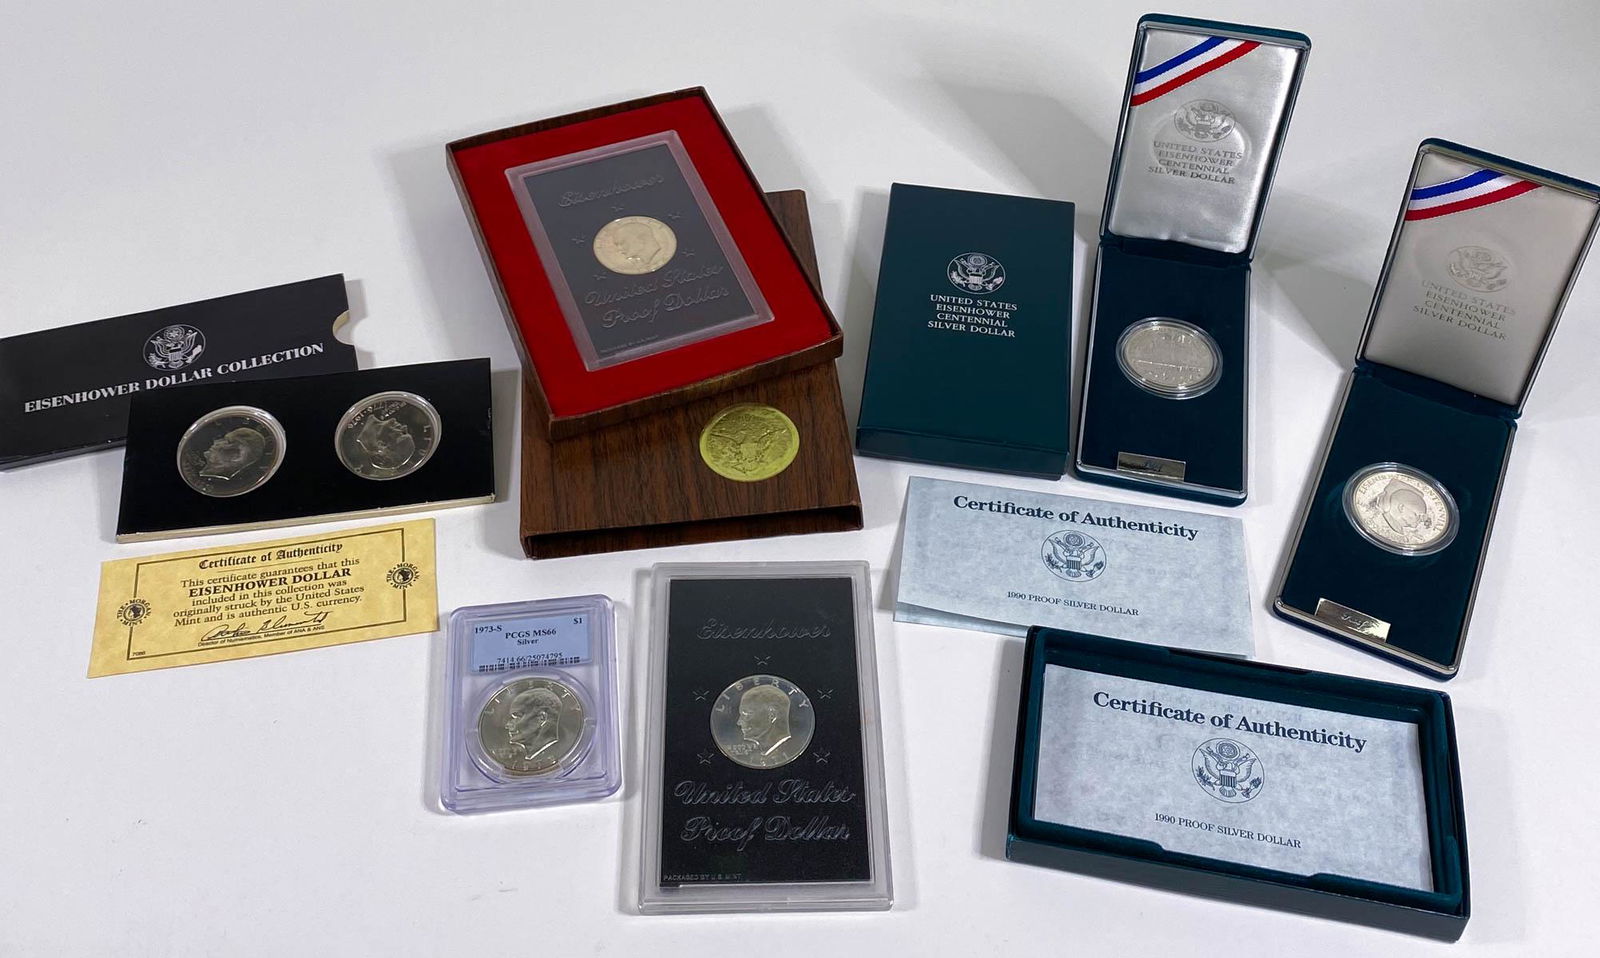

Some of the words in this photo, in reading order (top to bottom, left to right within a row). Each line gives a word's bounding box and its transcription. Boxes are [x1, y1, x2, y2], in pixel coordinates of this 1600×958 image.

[1153, 140, 1198, 154] UNITED
[1200, 147, 1243, 159] STATES
[1157, 150, 1234, 167] EISENHOWER
[1147, 165, 1188, 178] SILVER
[1190, 172, 1236, 185] DOLLAR
[1158, 158, 1230, 175] CENTENNIAL
[558, 174, 665, 207] Eisenhower
[602, 303, 660, 328] Proof
[663, 285, 730, 312] Dollar
[930, 293, 973, 306] UNITED
[976, 298, 1018, 311] STATES
[936, 303, 1011, 320] EISENHOWER
[1422, 279, 1469, 301] UNITED
[1471, 294, 1516, 316] STATES
[1426, 289, 1507, 323] EISENHOWER
[927, 320, 966, 332] SILVER
[970, 325, 1016, 338] DOLLAR
[937, 312, 1009, 328] CENTENNIAL
[1413, 304, 1454, 324] SILVER
[1457, 319, 1508, 341] DOLLAR
[1424, 299, 1502, 330] CENTENNIAL
[24, 380, 141, 414] EISENHOWER
[145, 366, 213, 393] DOLLAR
[216, 342, 325, 375] COLLECTION
[953, 494, 1055, 521] Certificate
[1058, 510, 1080, 524] of
[1082, 511, 1199, 541] Authenticity
[199, 555, 257, 570] Certificate
[261, 551, 273, 562] of
[276, 543, 343, 561] Authenticity
[180, 578, 204, 589] This
[207, 571, 257, 585] certificate
[260, 564, 314, 580] guarantees
[317, 561, 337, 571] that
[341, 557, 360, 568] this
[189, 577, 288, 598] EISENHOWER
[292, 567, 351, 585] DOLLAR
[173, 602, 222, 619] originally
[225, 599, 257, 612] struck
[260, 596, 273, 608] by
[276, 594, 293, 604] the
[296, 589, 332, 602] United
[334, 584, 365, 596] States
[192, 593, 236, 607] included
[239, 592, 250, 601] in
[253, 588, 273, 599] this
[275, 582, 324, 596] collection
[328, 579, 347, 588] was
[1007, 590, 1027, 601] 1990
[1028, 594, 1062, 606] PROOF
[1063, 598, 1097, 611] SILVER
[1099, 604, 1139, 617] DOLLAR
[174, 616, 201, 628] Mint
[204, 613, 223, 624] and
[226, 610, 236, 621] is
[238, 604, 288, 618] authentic
[291, 600, 314, 612] U.S.
[316, 595, 362, 610] currency.
[474, 625, 503, 634] 1973-S
[573, 617, 583, 625] $1
[505, 630, 531, 639] PCGS
[532, 628, 557, 637] MS66
[517, 638, 540, 646] Silver
[696, 617, 831, 640] Eisenhower
[716, 677, 810, 713] LIBERTY
[1093, 691, 1206, 724] Certificate
[1210, 713, 1235, 729] of
[1235, 716, 1368, 753] Authenticity
[674, 780, 768, 805] United
[773, 778, 856, 804] States
[680, 816, 763, 851] Proof
[764, 815, 850, 842] Dollar
[1154, 812, 1177, 825] 1990
[1178, 816, 1216, 833] PROOF
[1217, 824, 1254, 841] SILVER
[1257, 831, 1301, 849] DOLLAR
